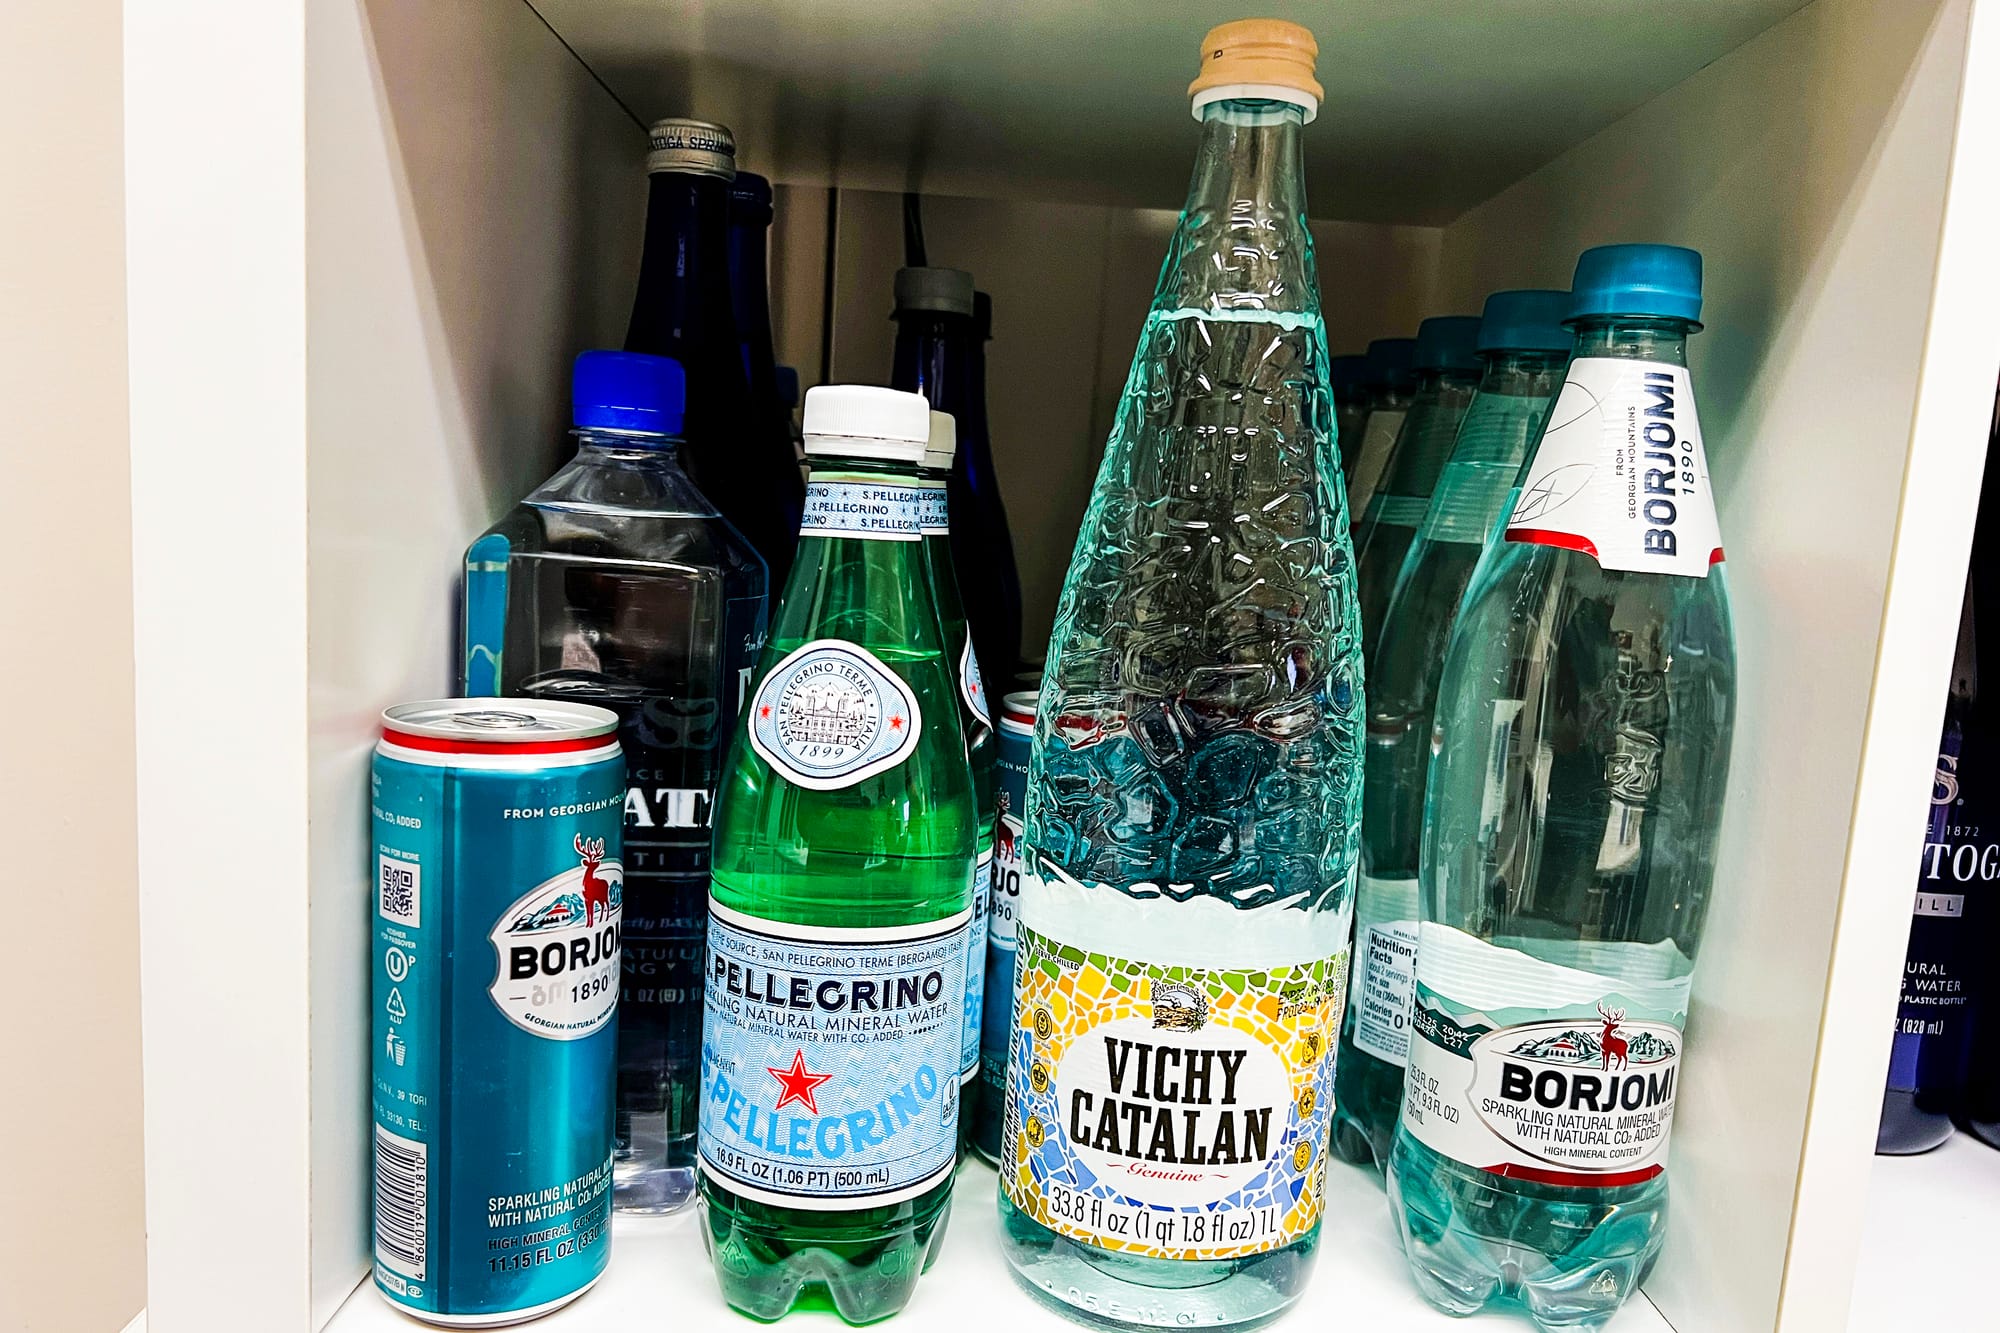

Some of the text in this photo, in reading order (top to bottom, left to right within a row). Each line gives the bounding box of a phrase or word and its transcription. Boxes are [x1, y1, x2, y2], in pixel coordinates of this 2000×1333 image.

[1616, 449, 1624, 476] FROM
[1628, 405, 1636, 520] GEORGIAN MOUNTAINS
[1643, 372, 1677, 557] BORJOMI
[1681, 440, 1695, 495] 1890
[779, 662, 834, 715] PELLEGRINO
[840, 665, 873, 697] TERME
[779, 720, 793, 745] SAN
[851, 715, 877, 750] ITALIA
[800, 744, 844, 759] 1899
[397, 815, 422, 829] ADDED
[503, 799, 607, 819] FROM GEORGIAN
[1946, 825, 1979, 837] 1872
[726, 938, 759, 959] SOURCE,
[763, 949, 784, 961] SAN
[788, 953, 855, 968] PELLEGRINO
[860, 956, 894, 968] TERME
[1035, 946, 1080, 971] SERVE CHILLED
[1370, 946, 1392, 965] Facts
[1371, 932, 1412, 957] Nutrition
[1386, 968, 1408, 985] servings
[1906, 961, 1947, 976] URAL
[572, 974, 609, 1004] 1890
[1915, 978, 1961, 992] WATER
[1364, 997, 1392, 1018] Calories
[1904, 995, 1938, 1006] PLASTIC
[524, 1012, 597, 1030] GEORGIAN NATURAL
[745, 1002, 948, 1032] NATURAL MINERAL WATER
[1371, 1012, 1390, 1026] serving
[1394, 1014, 1404, 1029] 0
[748, 1021, 784, 1039] MINERAL
[788, 1030, 818, 1042] WATER
[823, 1033, 847, 1044] WITH
[873, 1029, 903, 1042] ADDED
[1008, 996, 1021, 1068] MINERAL
[1104, 1036, 1247, 1105] VICHY
[1428, 1077, 1439, 1096] OZ
[1501, 1062, 1675, 1112] BORJOMI
[1422, 1092, 1433, 1111] 9.3
[1433, 1099, 1442, 1117] FL
[1443, 1104, 1460, 1125] OZ)
[1482, 1098, 1657, 1130] SPARKLING NATURAL MINERAL
[1002, 1071, 1016, 1178] CARBONATED
[1070, 1088, 1272, 1165] CATALAN
[1516, 1121, 1553, 1141] WITH
[1553, 1128, 1611, 1145] NATURAL
[1634, 1123, 1661, 1143] ADDED
[1544, 1145, 1643, 1159] HIGH MINERAL CONTENT
[717, 1147, 890, 1190] 16.9 FL OZ (1.06 PT) (500 mL)
[1127, 1162, 1204, 1182] Genuine
[488, 1166, 602, 1212] SPARKLING NATURAL
[488, 1211, 521, 1228] WITH
[525, 1197, 575, 1223] NATURAL
[1051, 1186, 1085, 1223] 33.8
[1091, 1199, 1102, 1229] fl
[1107, 1214, 1129, 1235] oz
[1135, 1210, 1150, 1240] (1
[1156, 1217, 1175, 1246] qt
[1182, 1216, 1205, 1242] 1.8
[1212, 1214, 1224, 1242] fl
[1229, 1211, 1255, 1241] oz)
[488, 1223, 571, 1251] HIGH MINERAL
[488, 1252, 532, 1273] 11.15
[535, 1247, 553, 1266] FL
[556, 1239, 575, 1259] OZ
